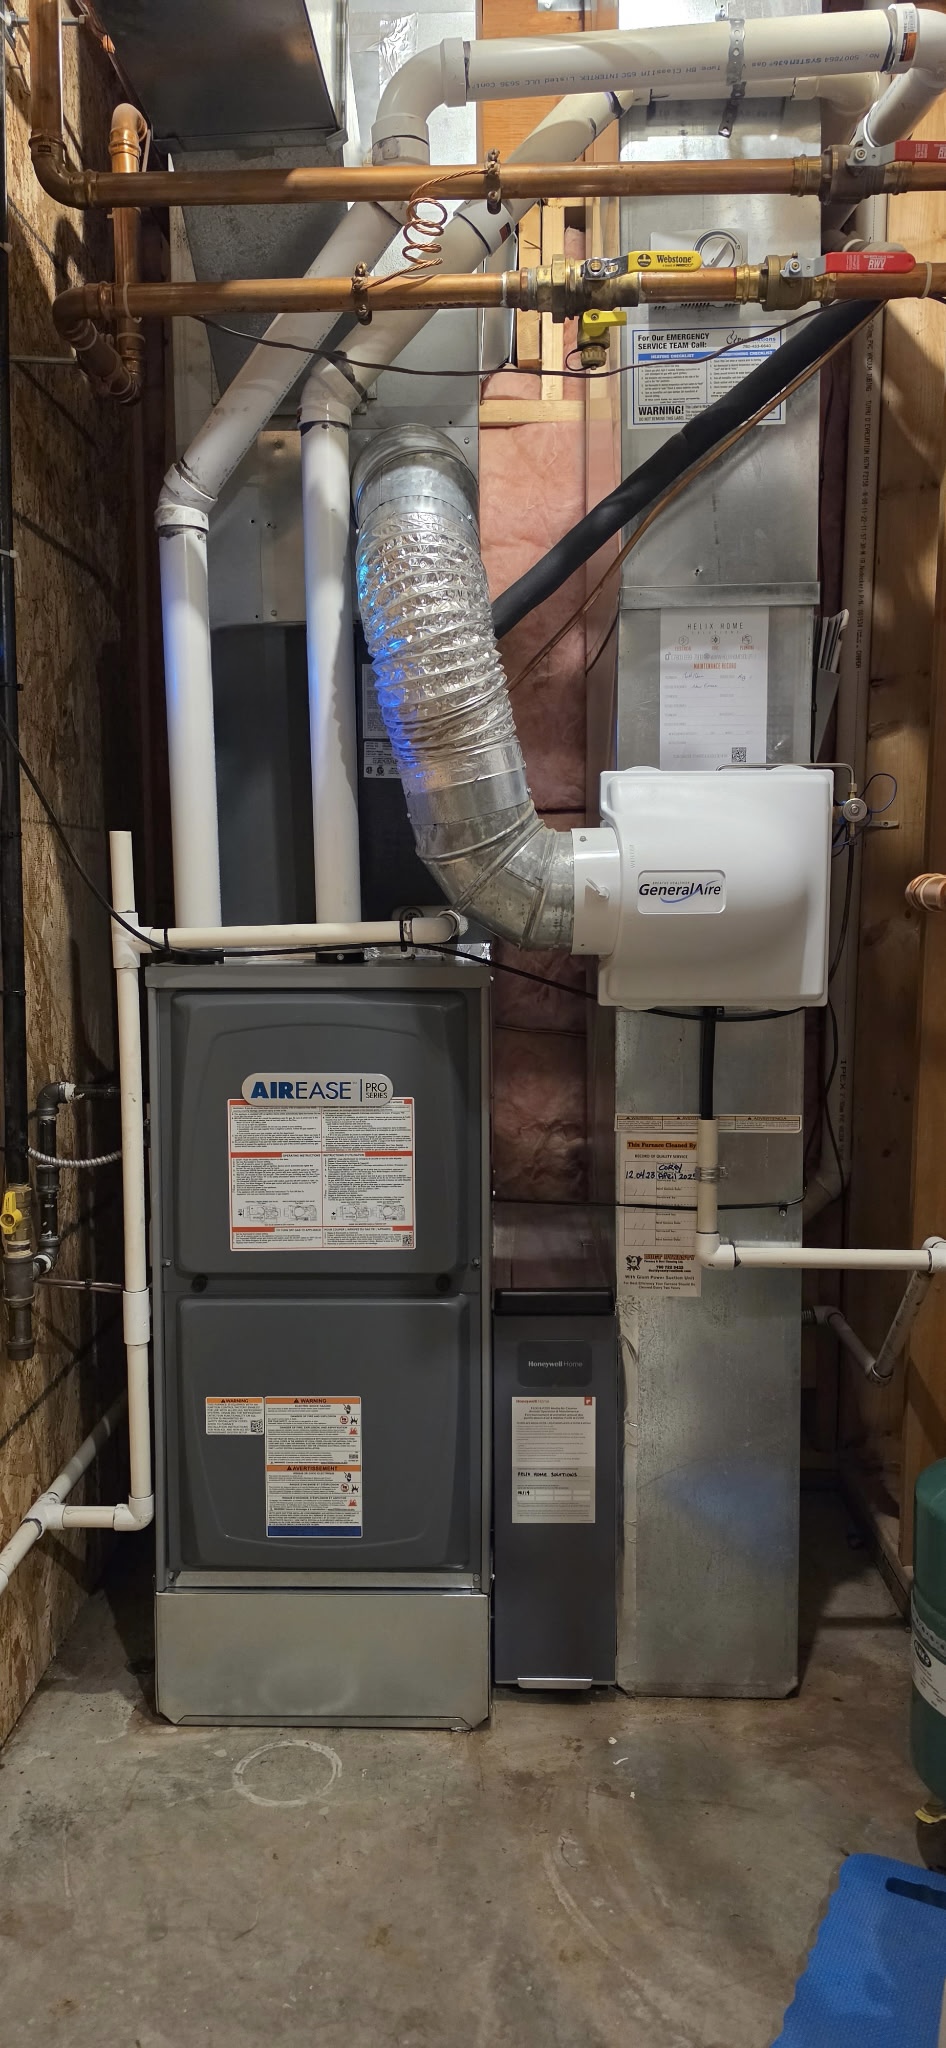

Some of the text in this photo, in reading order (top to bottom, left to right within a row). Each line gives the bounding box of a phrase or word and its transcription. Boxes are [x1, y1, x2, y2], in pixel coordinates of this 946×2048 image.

[544, 76, 576, 84] Listed
[579, 74, 619, 82] INTERTEK
[656, 255, 692, 263] Webstone
[868, 258, 887, 270] RWV
[638, 342, 671, 350] SERVICE
[638, 406, 684, 415] WARNING!
[639, 882, 721, 896] GeneralAire
[251, 1081, 352, 1099] AIREASE
[365, 1082, 387, 1092] PRO
